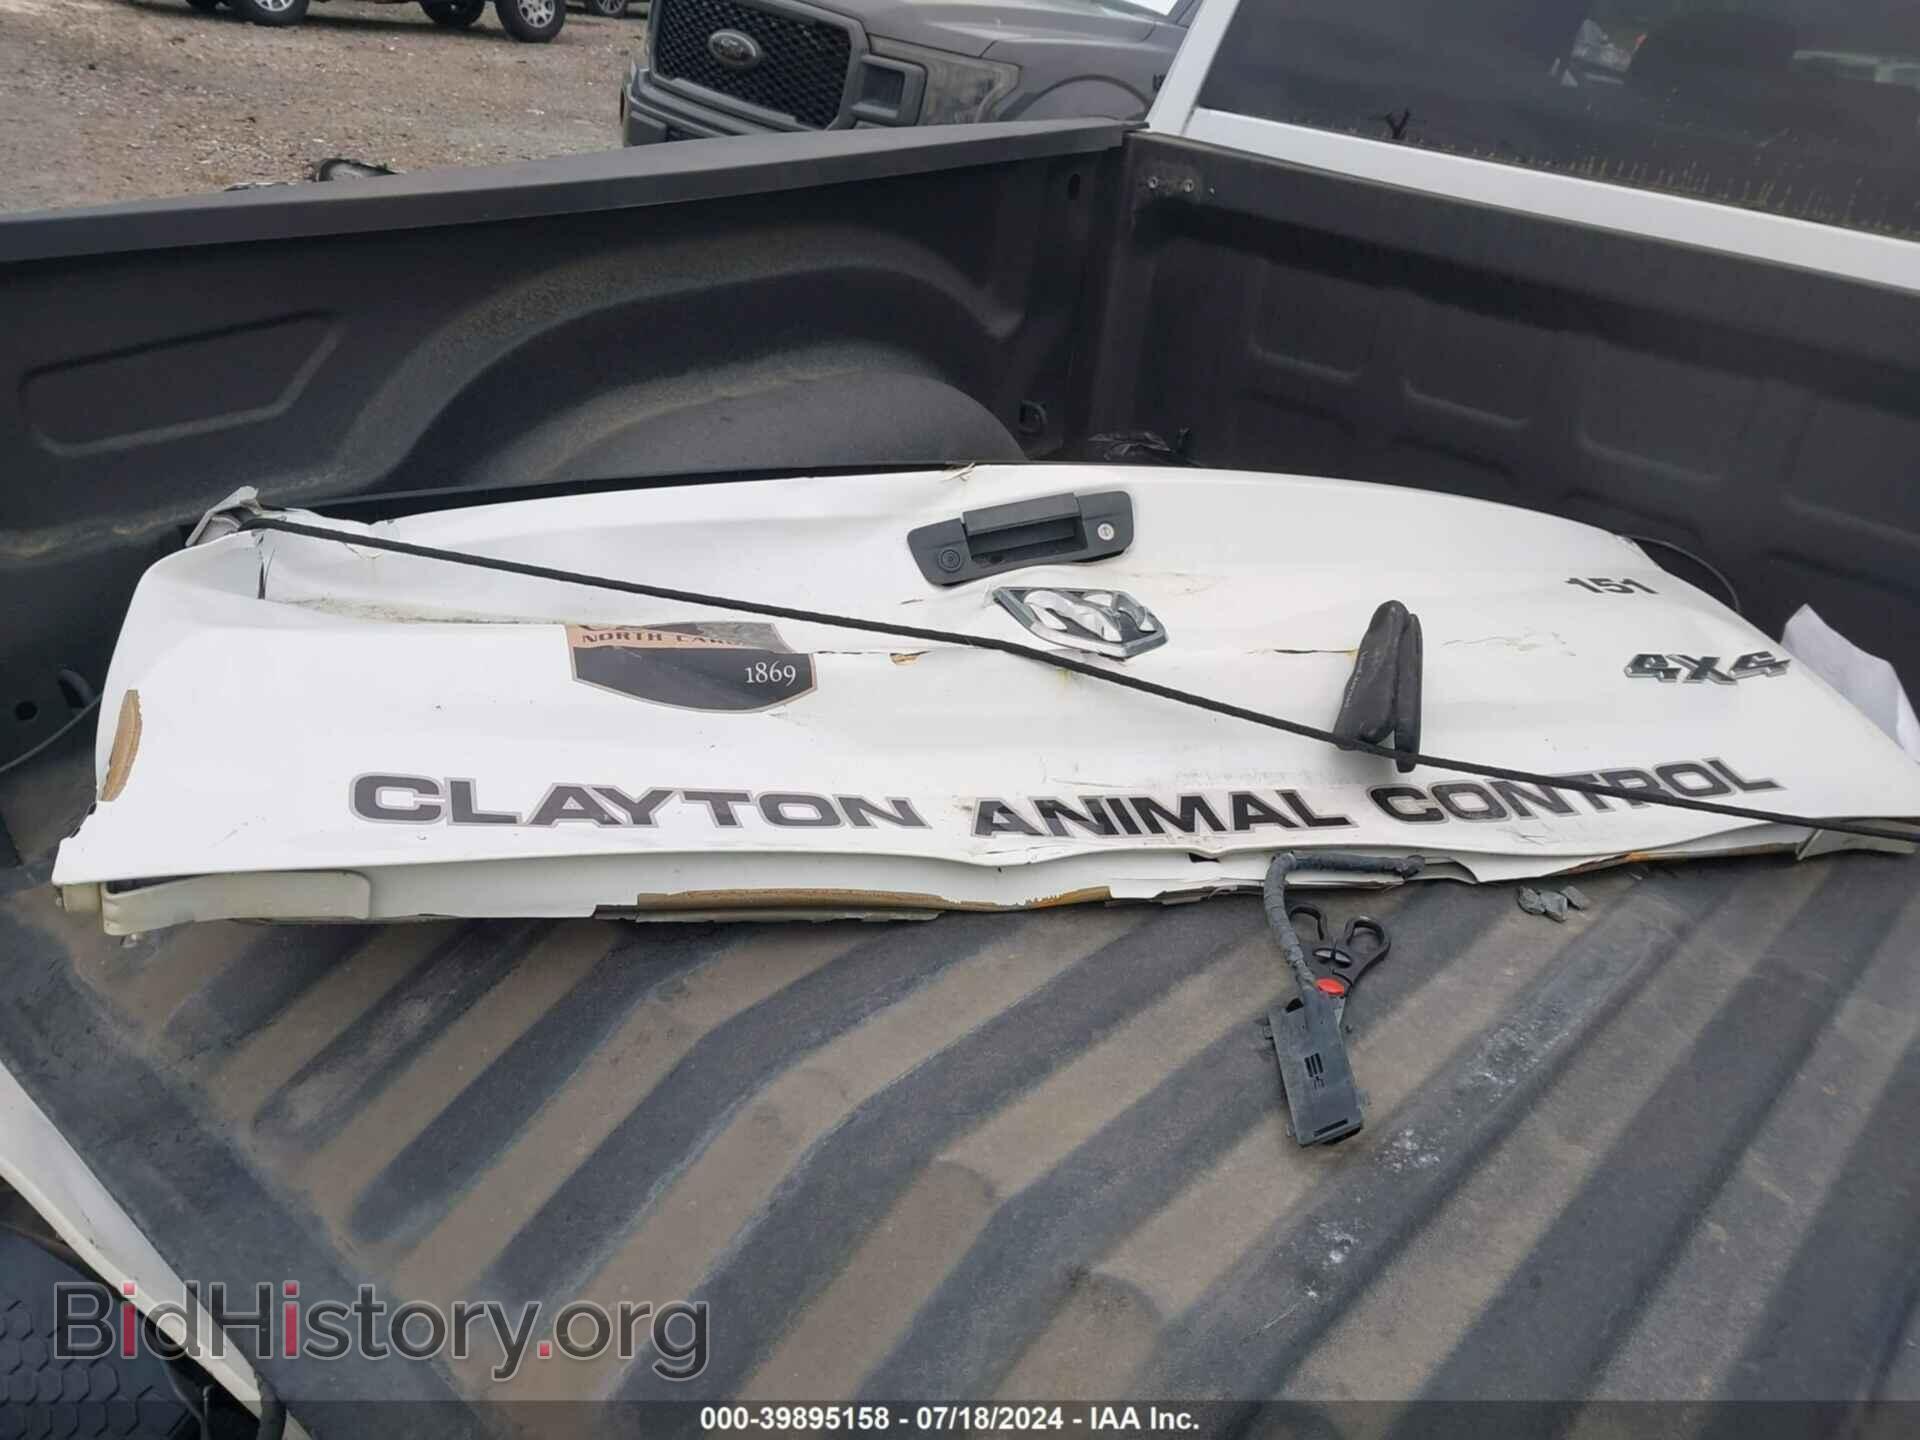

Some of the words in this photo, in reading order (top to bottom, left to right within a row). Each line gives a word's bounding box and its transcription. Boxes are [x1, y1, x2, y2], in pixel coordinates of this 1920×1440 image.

[1565, 577, 1659, 594] 151
[582, 631, 662, 643] NORTH
[745, 661, 796, 686] 1869
[349, 772, 931, 829] CLAYTON
[971, 789, 1356, 838] ANIMAL
[1367, 756, 1787, 824] CONTROL
